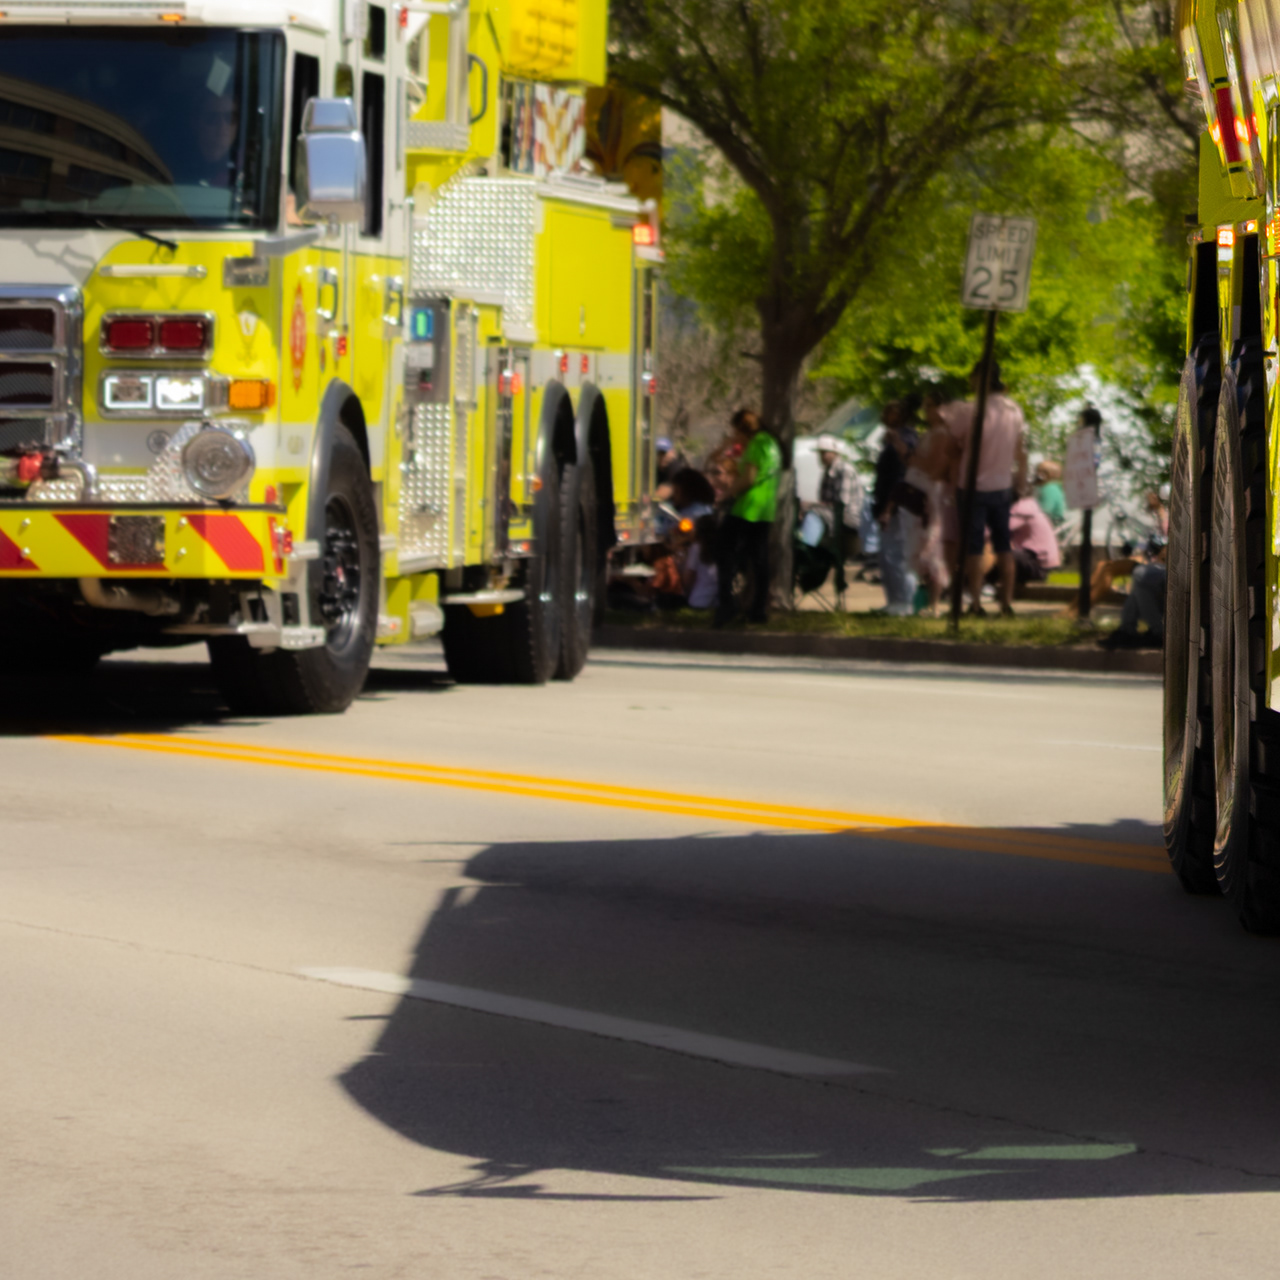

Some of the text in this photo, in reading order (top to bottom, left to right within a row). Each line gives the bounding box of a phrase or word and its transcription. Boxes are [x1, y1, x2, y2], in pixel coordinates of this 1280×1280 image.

[973, 222, 1030, 244] SPEED
[976, 245, 1023, 265] LIMIT
[969, 266, 1018, 301] 25
